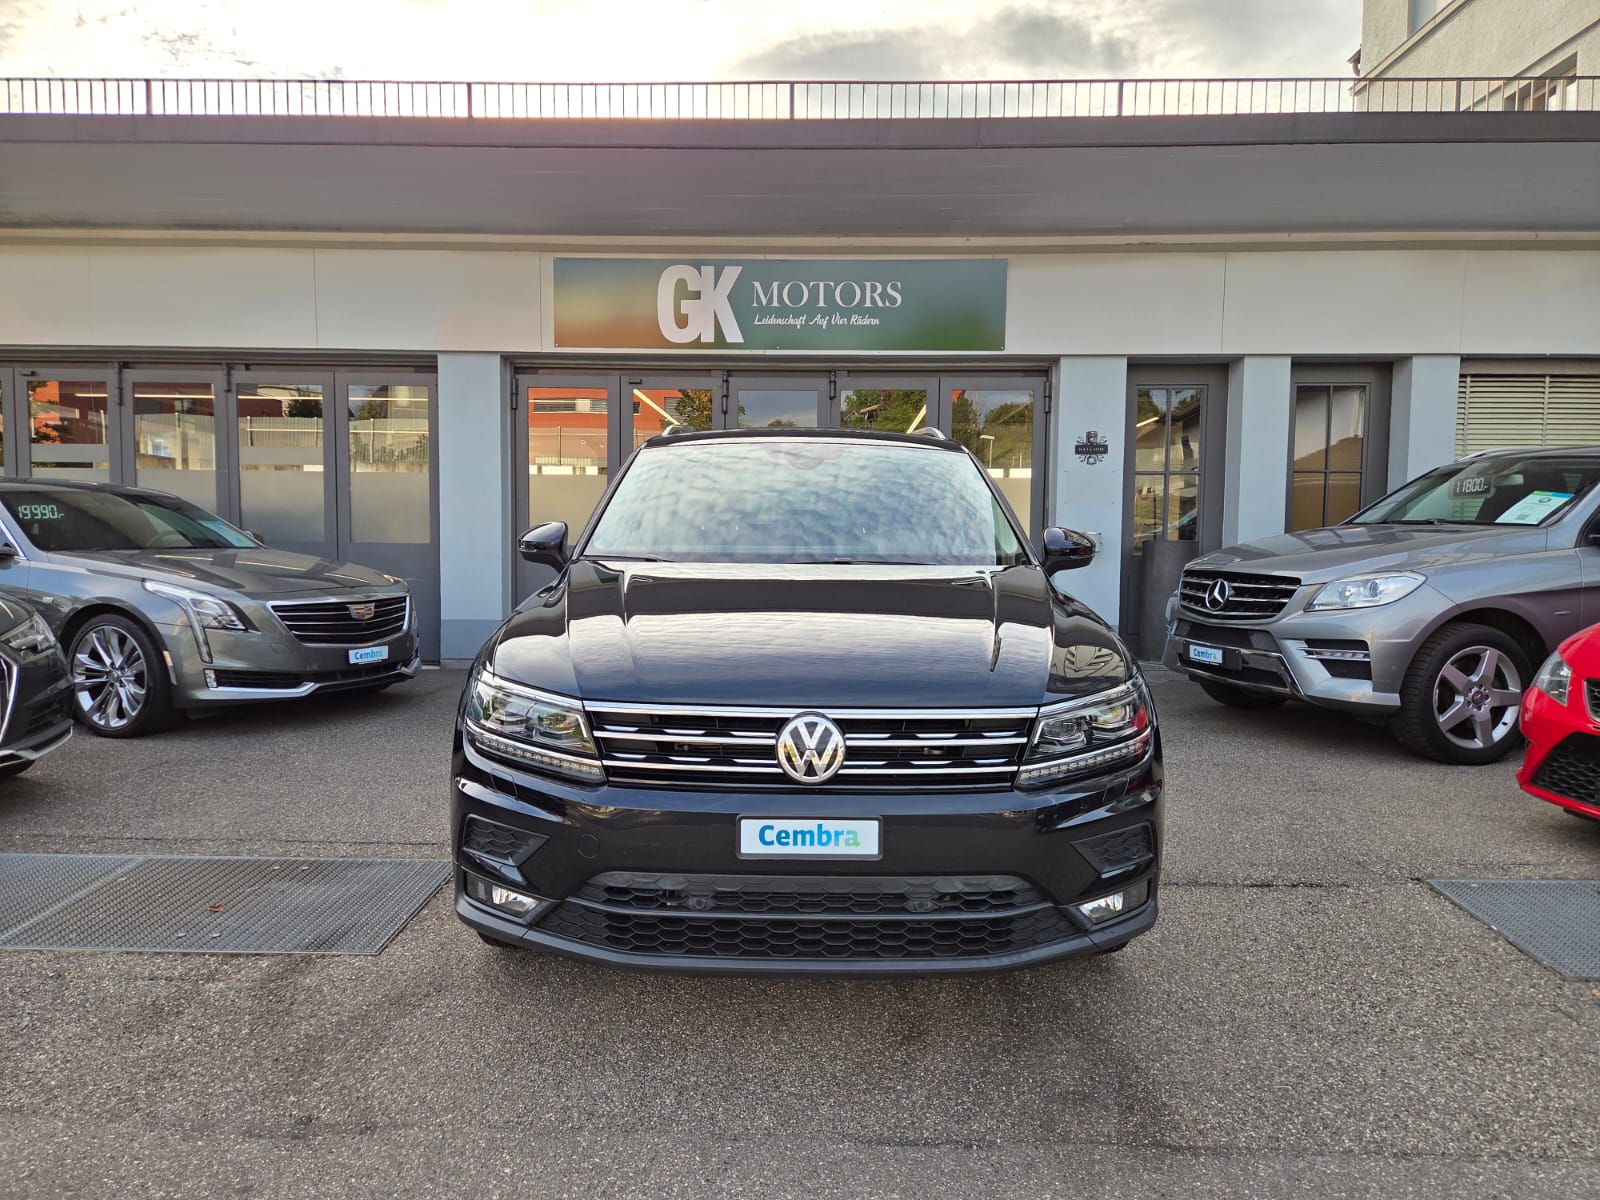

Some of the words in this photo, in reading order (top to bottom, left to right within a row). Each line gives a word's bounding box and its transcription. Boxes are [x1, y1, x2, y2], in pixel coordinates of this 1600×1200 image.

[657, 264, 744, 343] GK
[752, 281, 902, 308] MOTORS
[754, 314, 806, 329] Leidenschaft
[808, 315, 829, 329] Auf
[831, 312, 848, 325] Vier
[850, 313, 880, 325] Rädern
[1193, 648, 1217, 660] Cembra
[783, 716, 841, 781] VW
[758, 823, 861, 847] Cembra
